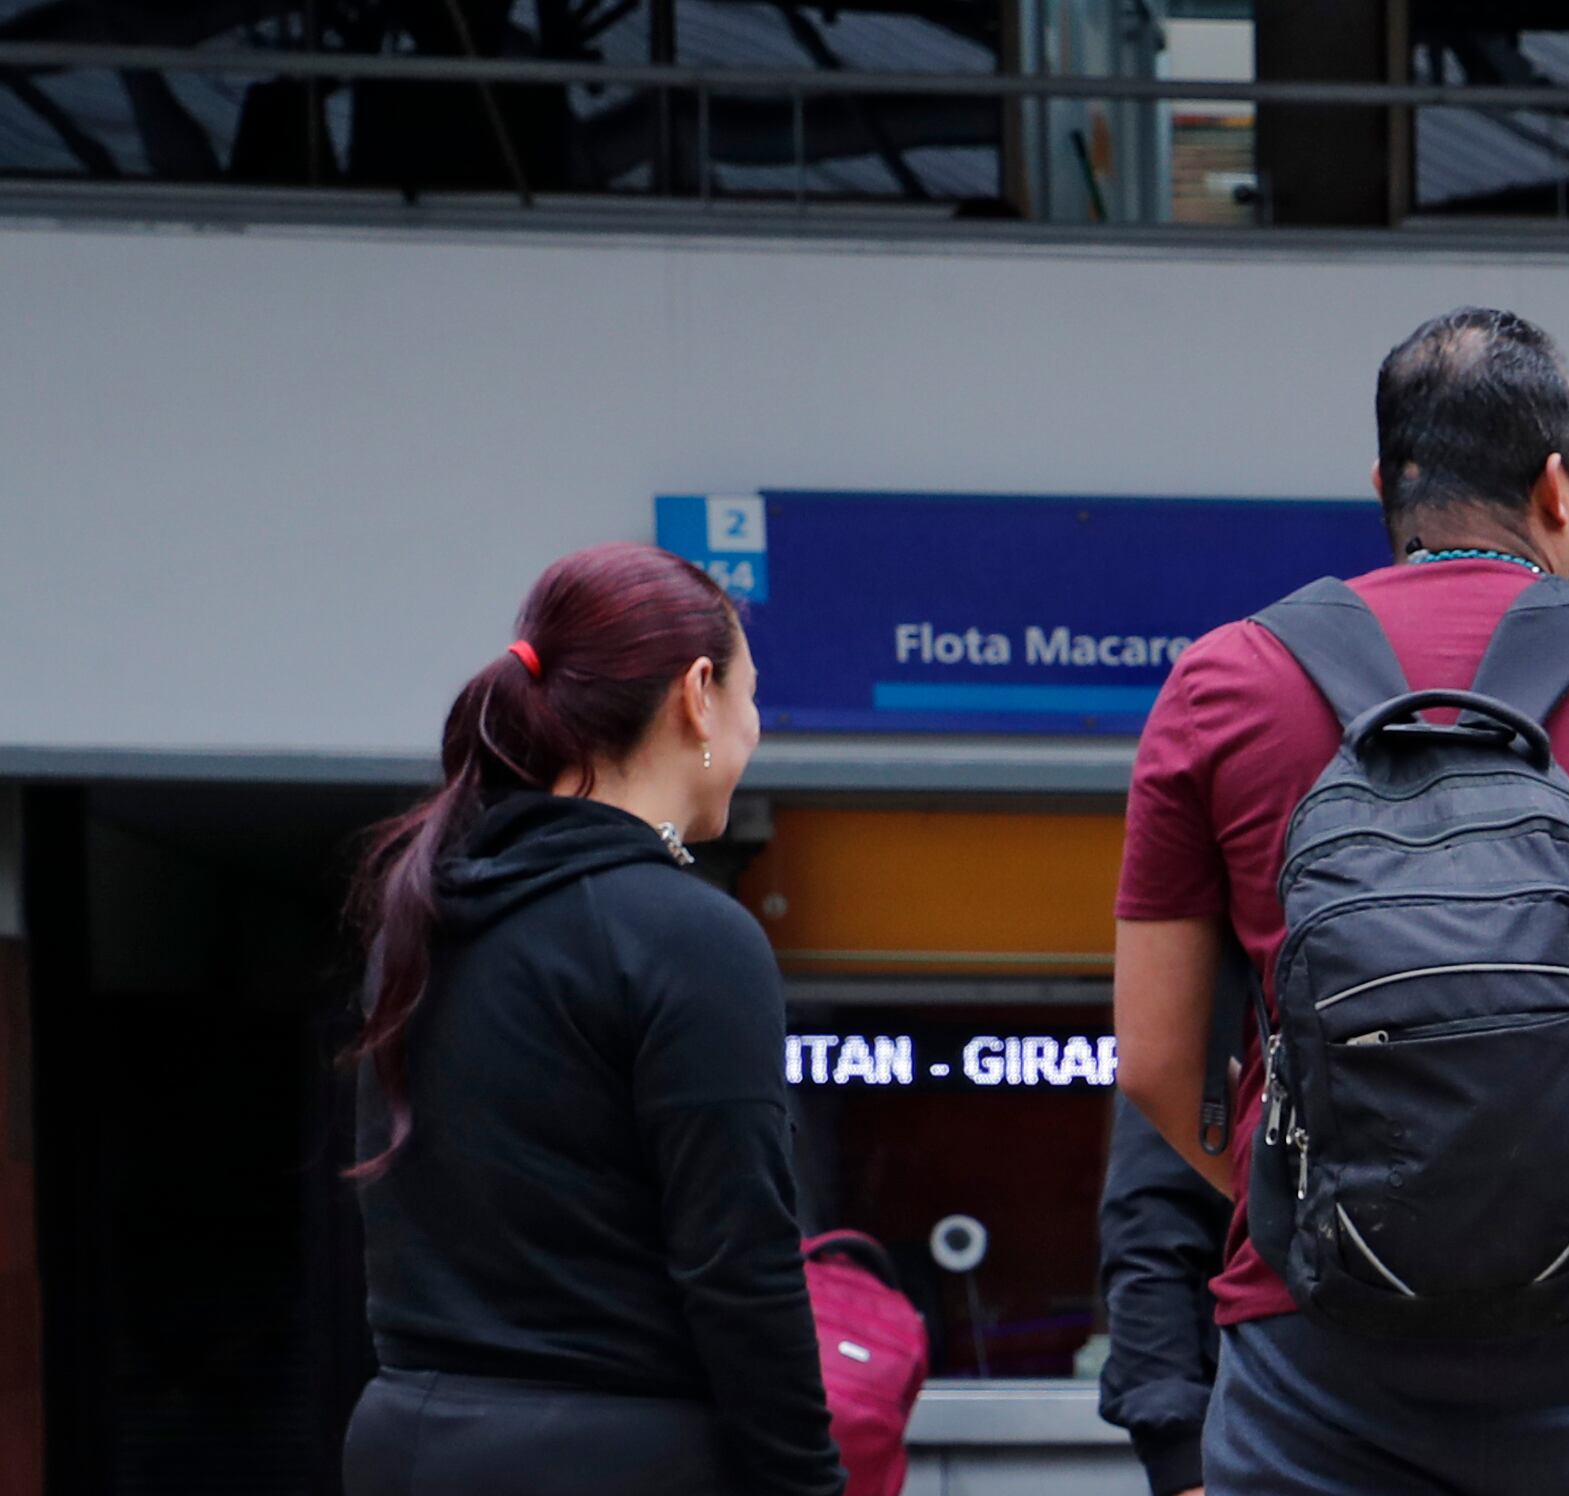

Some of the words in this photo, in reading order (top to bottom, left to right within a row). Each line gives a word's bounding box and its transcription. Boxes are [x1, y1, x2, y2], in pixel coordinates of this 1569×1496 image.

[725, 508, 747, 538] 2
[692, 560, 754, 592] 54
[895, 621, 1011, 665] Flota
